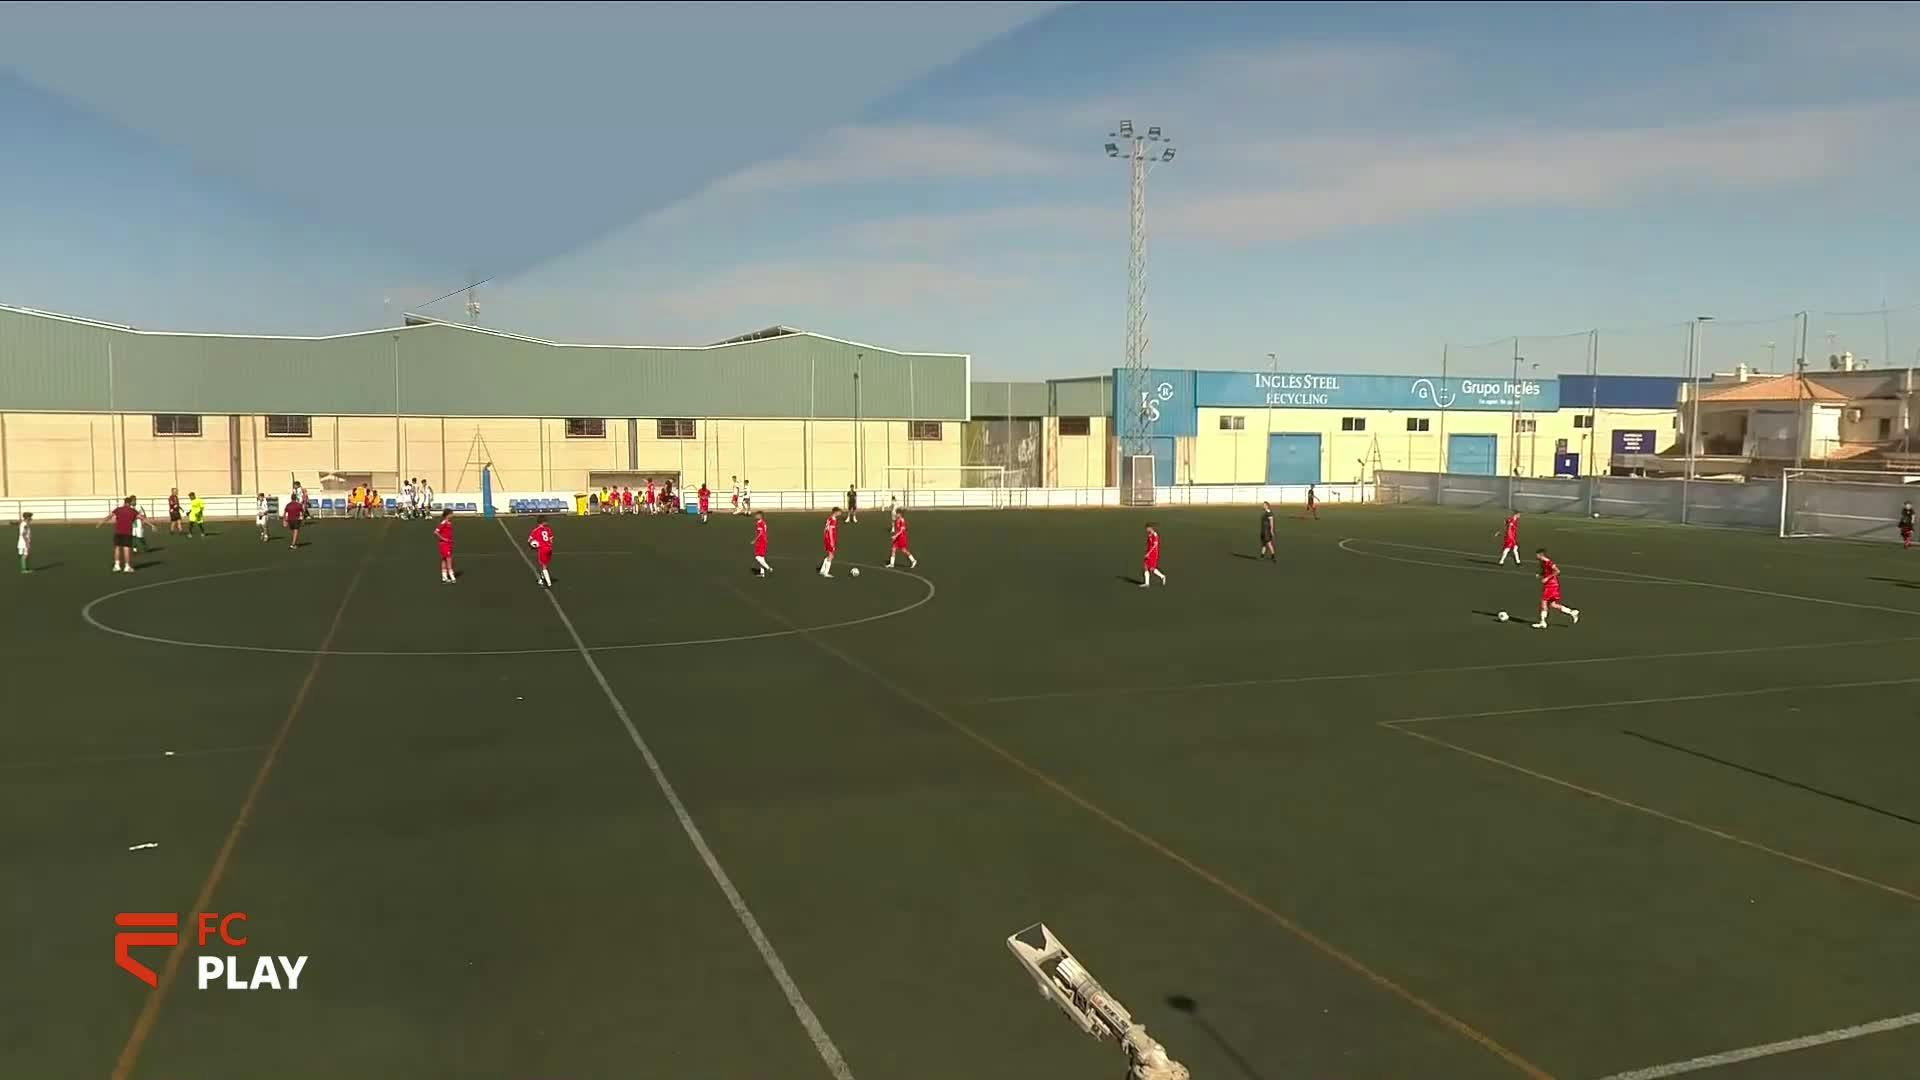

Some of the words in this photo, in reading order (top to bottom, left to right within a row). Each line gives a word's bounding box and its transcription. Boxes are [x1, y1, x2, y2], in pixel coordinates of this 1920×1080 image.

[1303, 374, 1340, 389] STEEL
[1462, 380, 1500, 397] Grupo
[1504, 380, 1540, 398] Inglés
[1266, 393, 1328, 405] RECYCLING
[541, 530, 549, 542] 8
